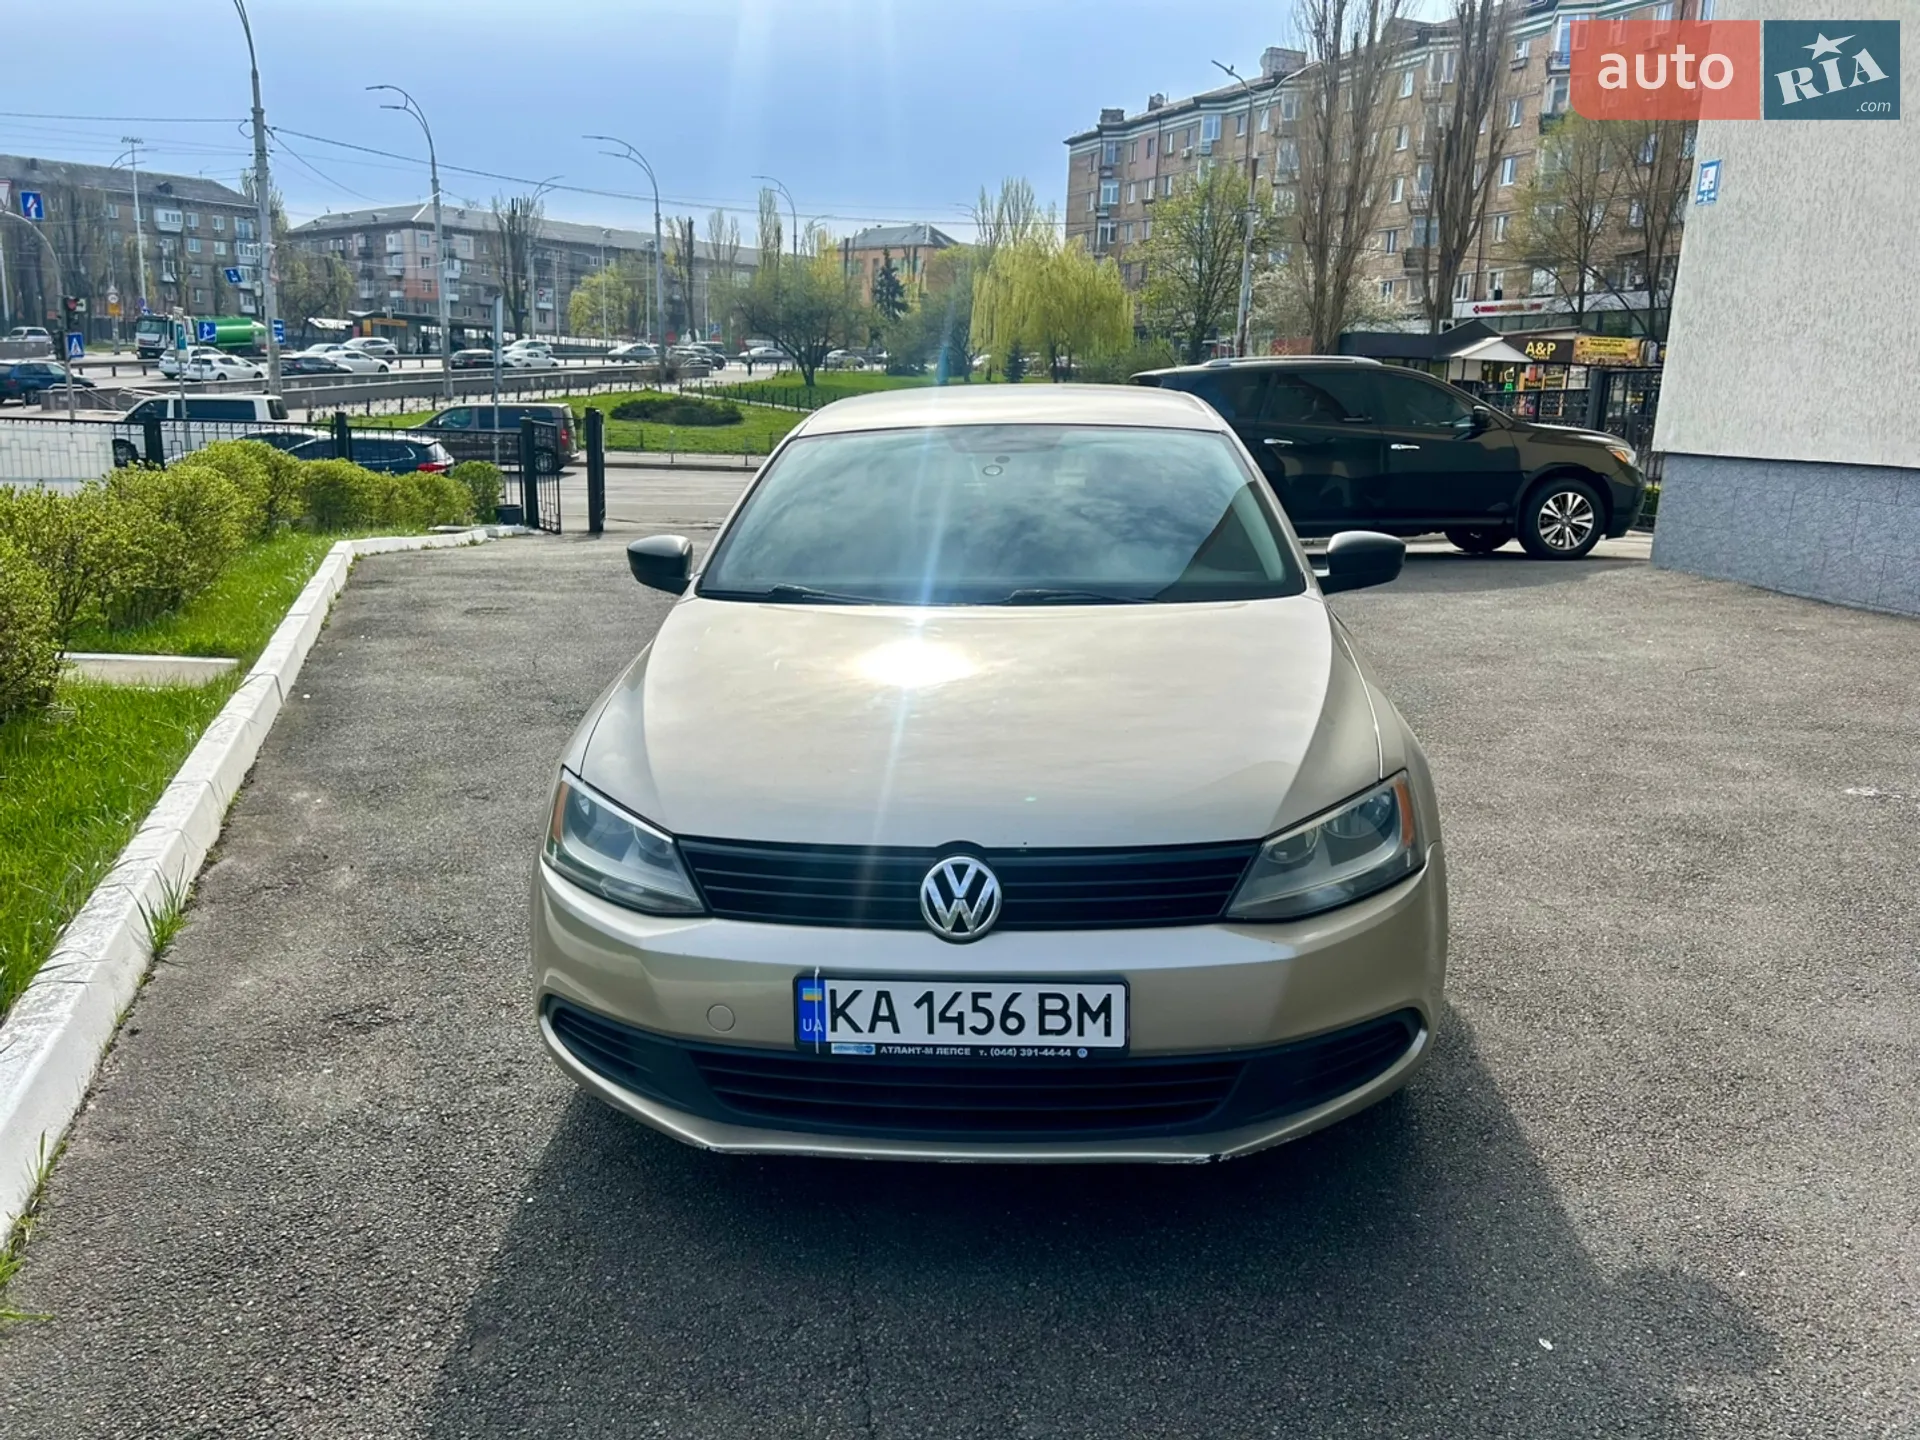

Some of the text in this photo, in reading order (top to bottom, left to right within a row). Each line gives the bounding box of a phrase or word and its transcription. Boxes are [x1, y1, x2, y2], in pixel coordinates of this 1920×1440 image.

[1525, 341, 1556, 355] A&P
[829, 989, 1112, 1037] KA 1456 BM
[802, 1018, 823, 1033] UA
[880, 1046, 933, 1055] АТЛАНТ-М
[935, 1047, 971, 1056] ЛЕПСЕ
[990, 1047, 1017, 1057] (044)
[1020, 1048, 1072, 1057] 391-44-44
